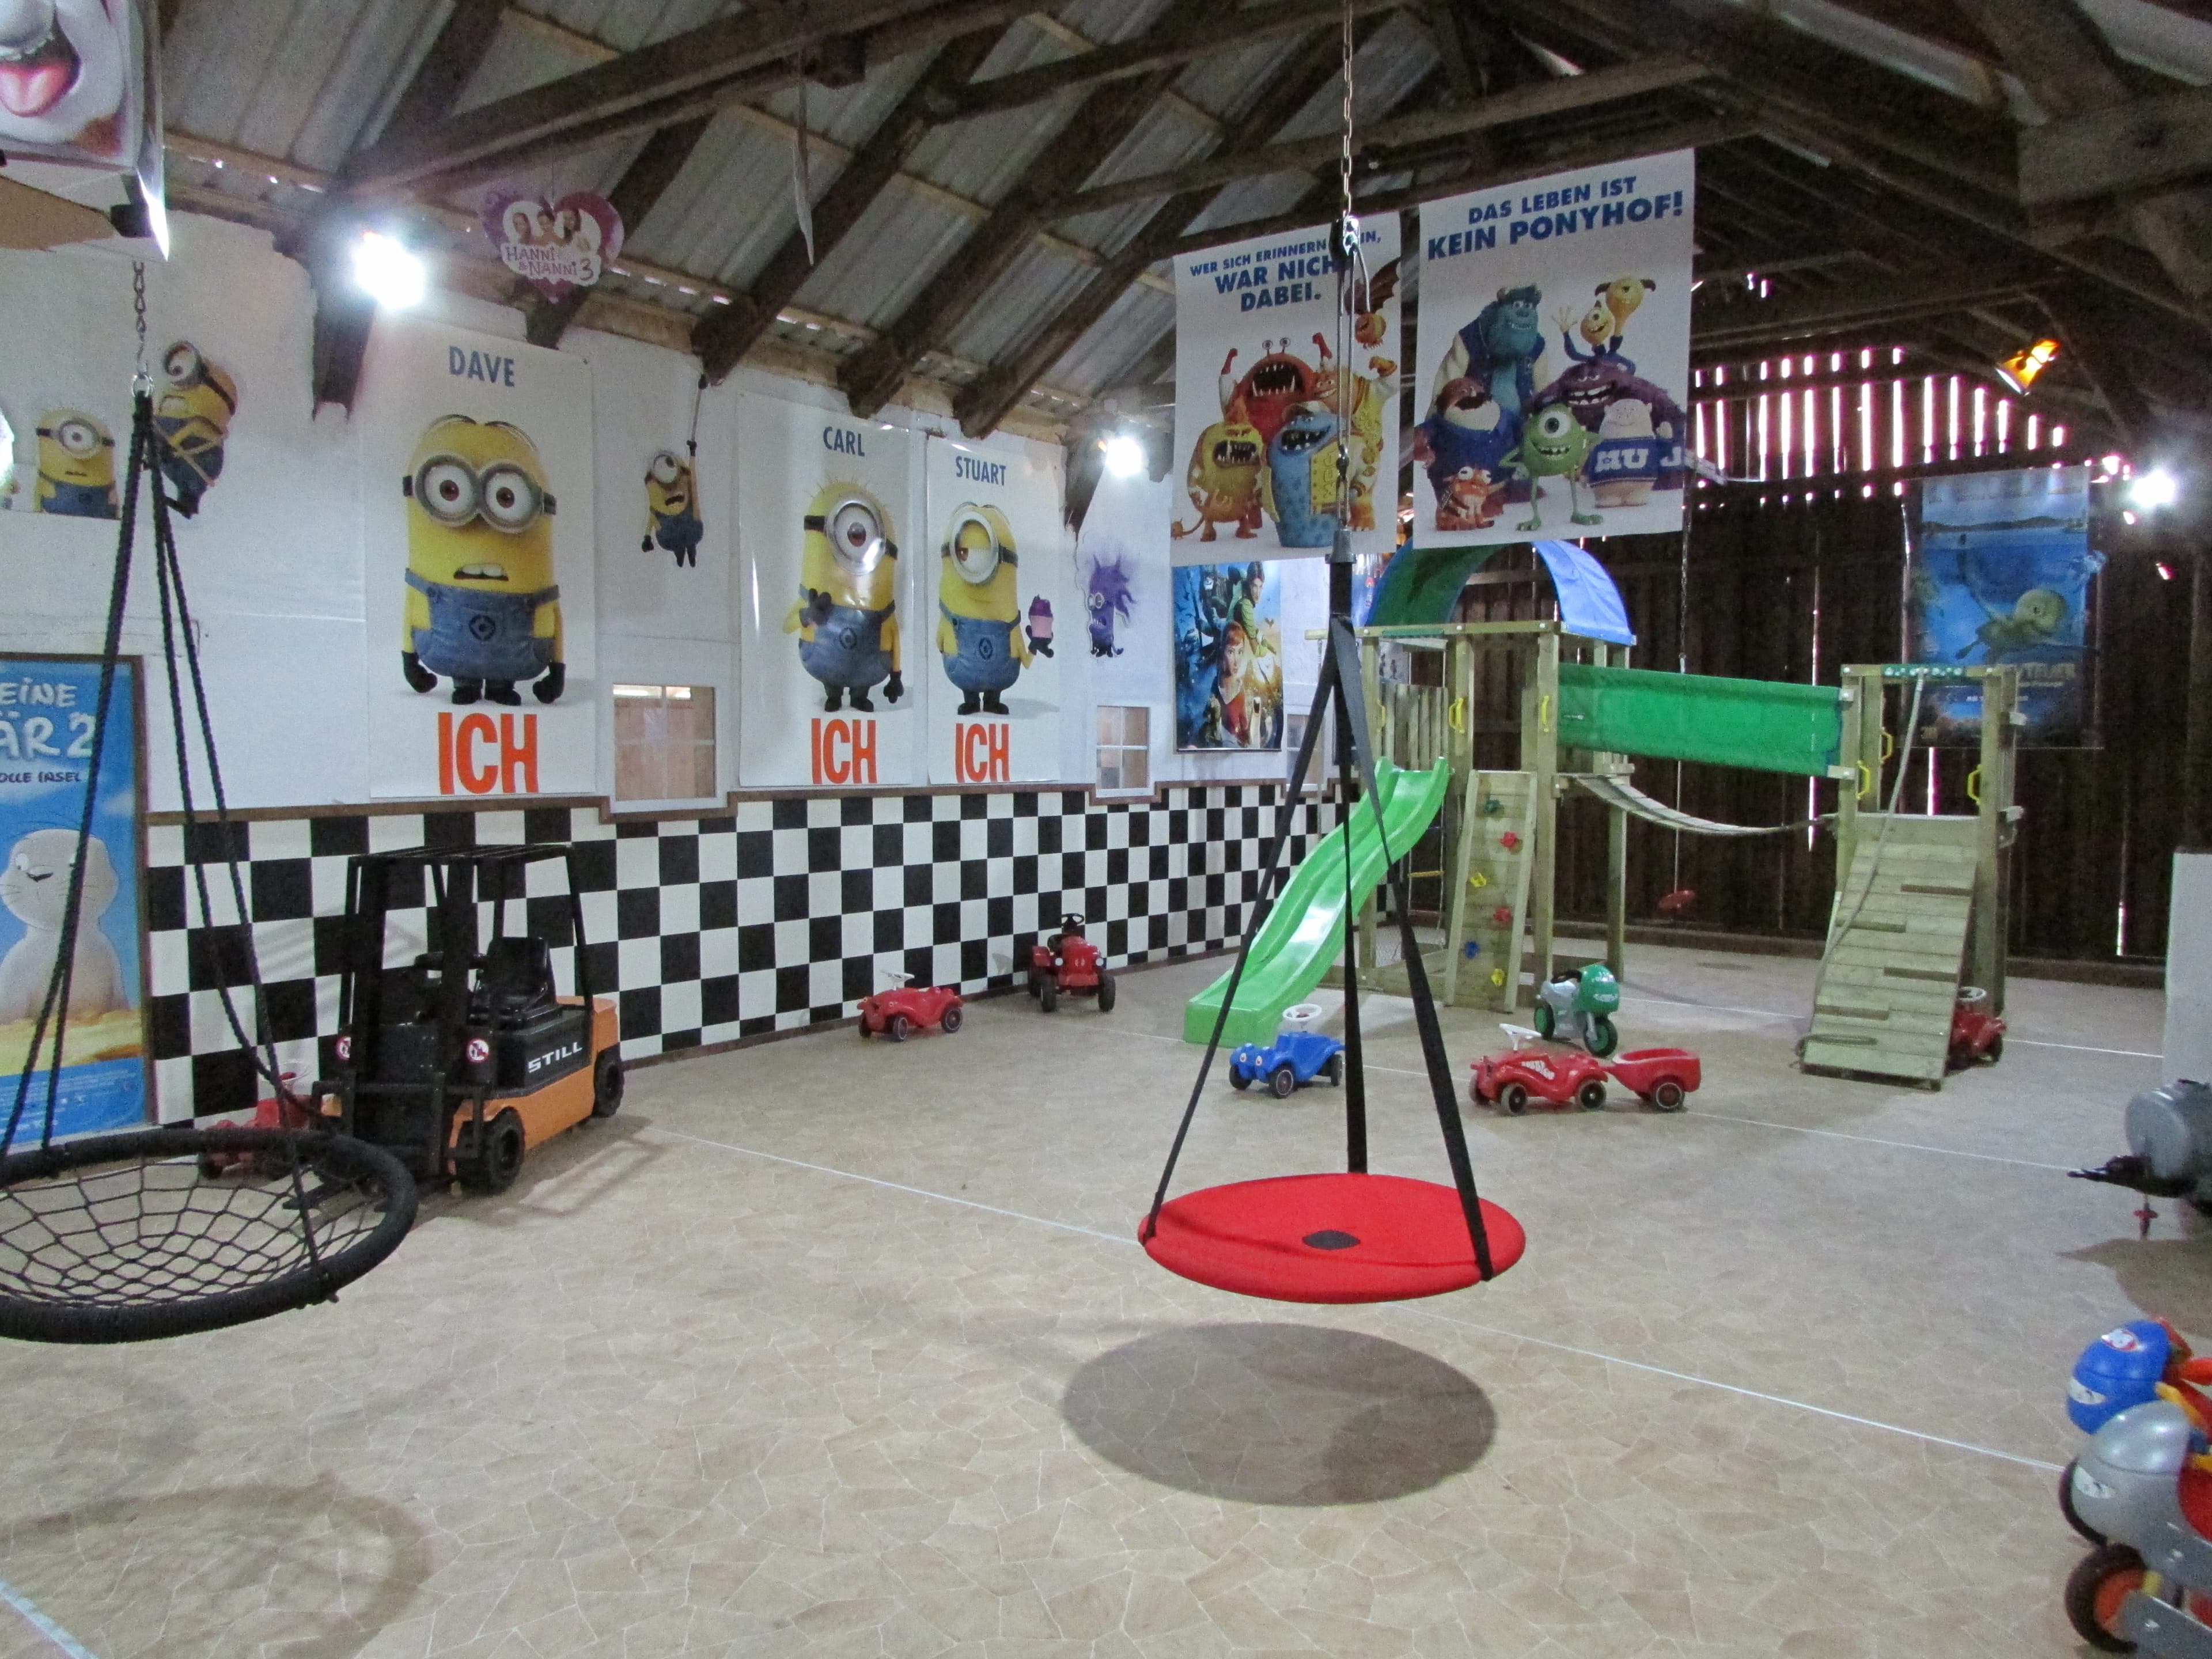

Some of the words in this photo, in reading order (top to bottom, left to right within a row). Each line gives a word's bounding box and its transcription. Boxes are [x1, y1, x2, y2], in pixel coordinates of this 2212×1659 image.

[1468, 200, 1512, 224] DAS
[1521, 184, 1590, 214] LEBEN
[1601, 176, 1637, 198] IST
[1428, 226, 1496, 260] KEIN
[1510, 191, 1683, 244] PONYHOF!
[580, 258, 594, 281] 3
[1190, 261, 1218, 276] WER
[1224, 253, 1251, 270] SICH
[1256, 238, 1327, 262] ERINNERN
[1215, 267, 1268, 294] WAR
[1278, 255, 1338, 281] NICH
[1241, 282, 1321, 312] DABEI.
[449, 346, 515, 387] DAVE
[823, 426, 866, 456] CARL
[956, 456, 1006, 486] STUART
[67, 711, 97, 758] 2
[438, 712, 539, 795] ICH
[811, 718, 877, 785] ICH
[955, 723, 1010, 783] ICH
[528, 1041, 583, 1073] STILL
